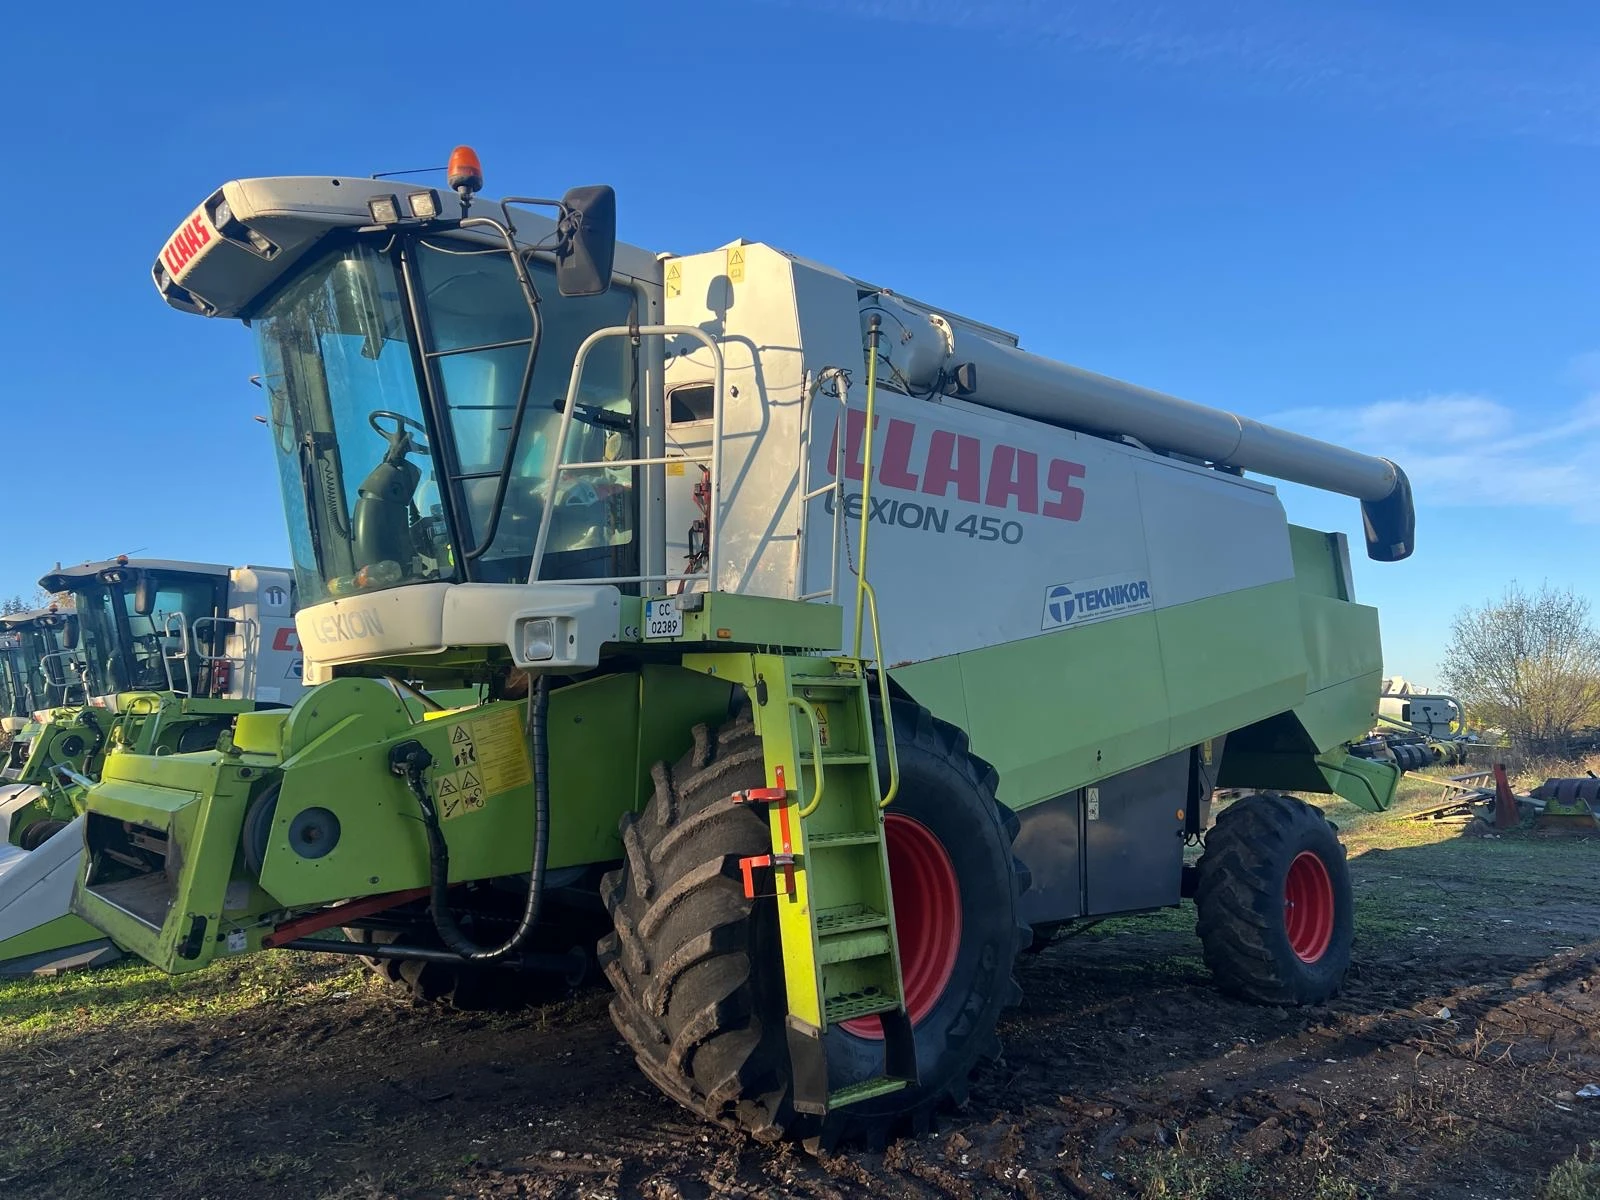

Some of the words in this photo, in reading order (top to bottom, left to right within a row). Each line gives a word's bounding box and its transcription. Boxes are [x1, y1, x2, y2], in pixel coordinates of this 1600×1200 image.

[164, 215, 211, 276] CLAAS
[826, 407, 1086, 522] CLAAS
[954, 514, 1024, 545] 450
[311, 607, 384, 644] LEXION
[659, 603, 671, 616] CC
[651, 620, 678, 634] 02389
